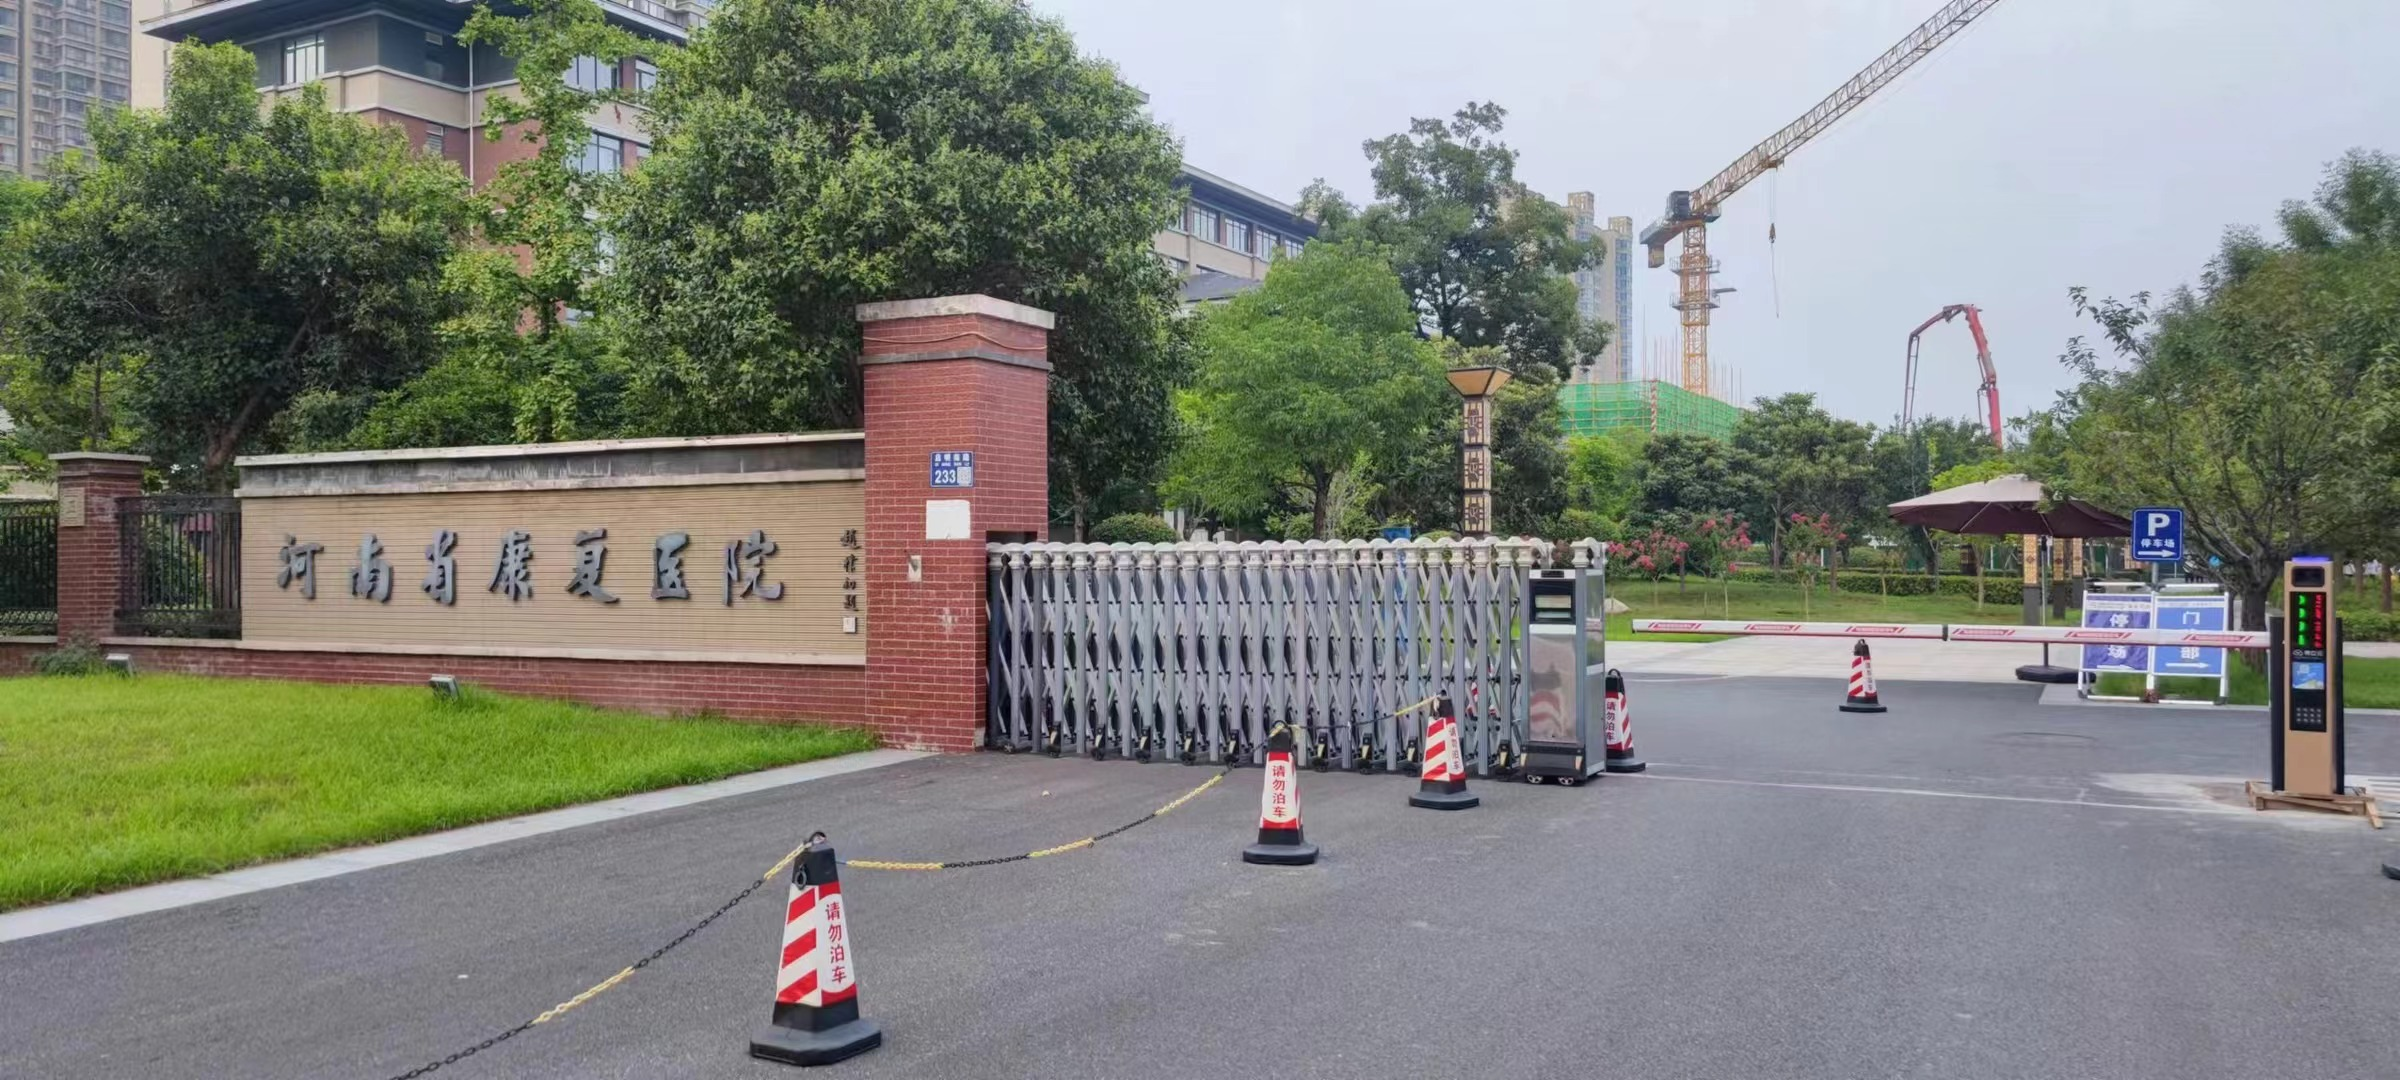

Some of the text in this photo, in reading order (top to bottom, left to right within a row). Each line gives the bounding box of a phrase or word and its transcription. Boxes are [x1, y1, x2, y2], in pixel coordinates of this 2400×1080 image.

[934, 469, 956, 484] 233
[2140, 538, 2175, 548] 停车场
[2147, 513, 2170, 537] P
[277, 528, 785, 607] 河南省康复医院
[1272, 765, 1286, 818] 请勿泊车
[825, 901, 847, 984] 请勿泊车
